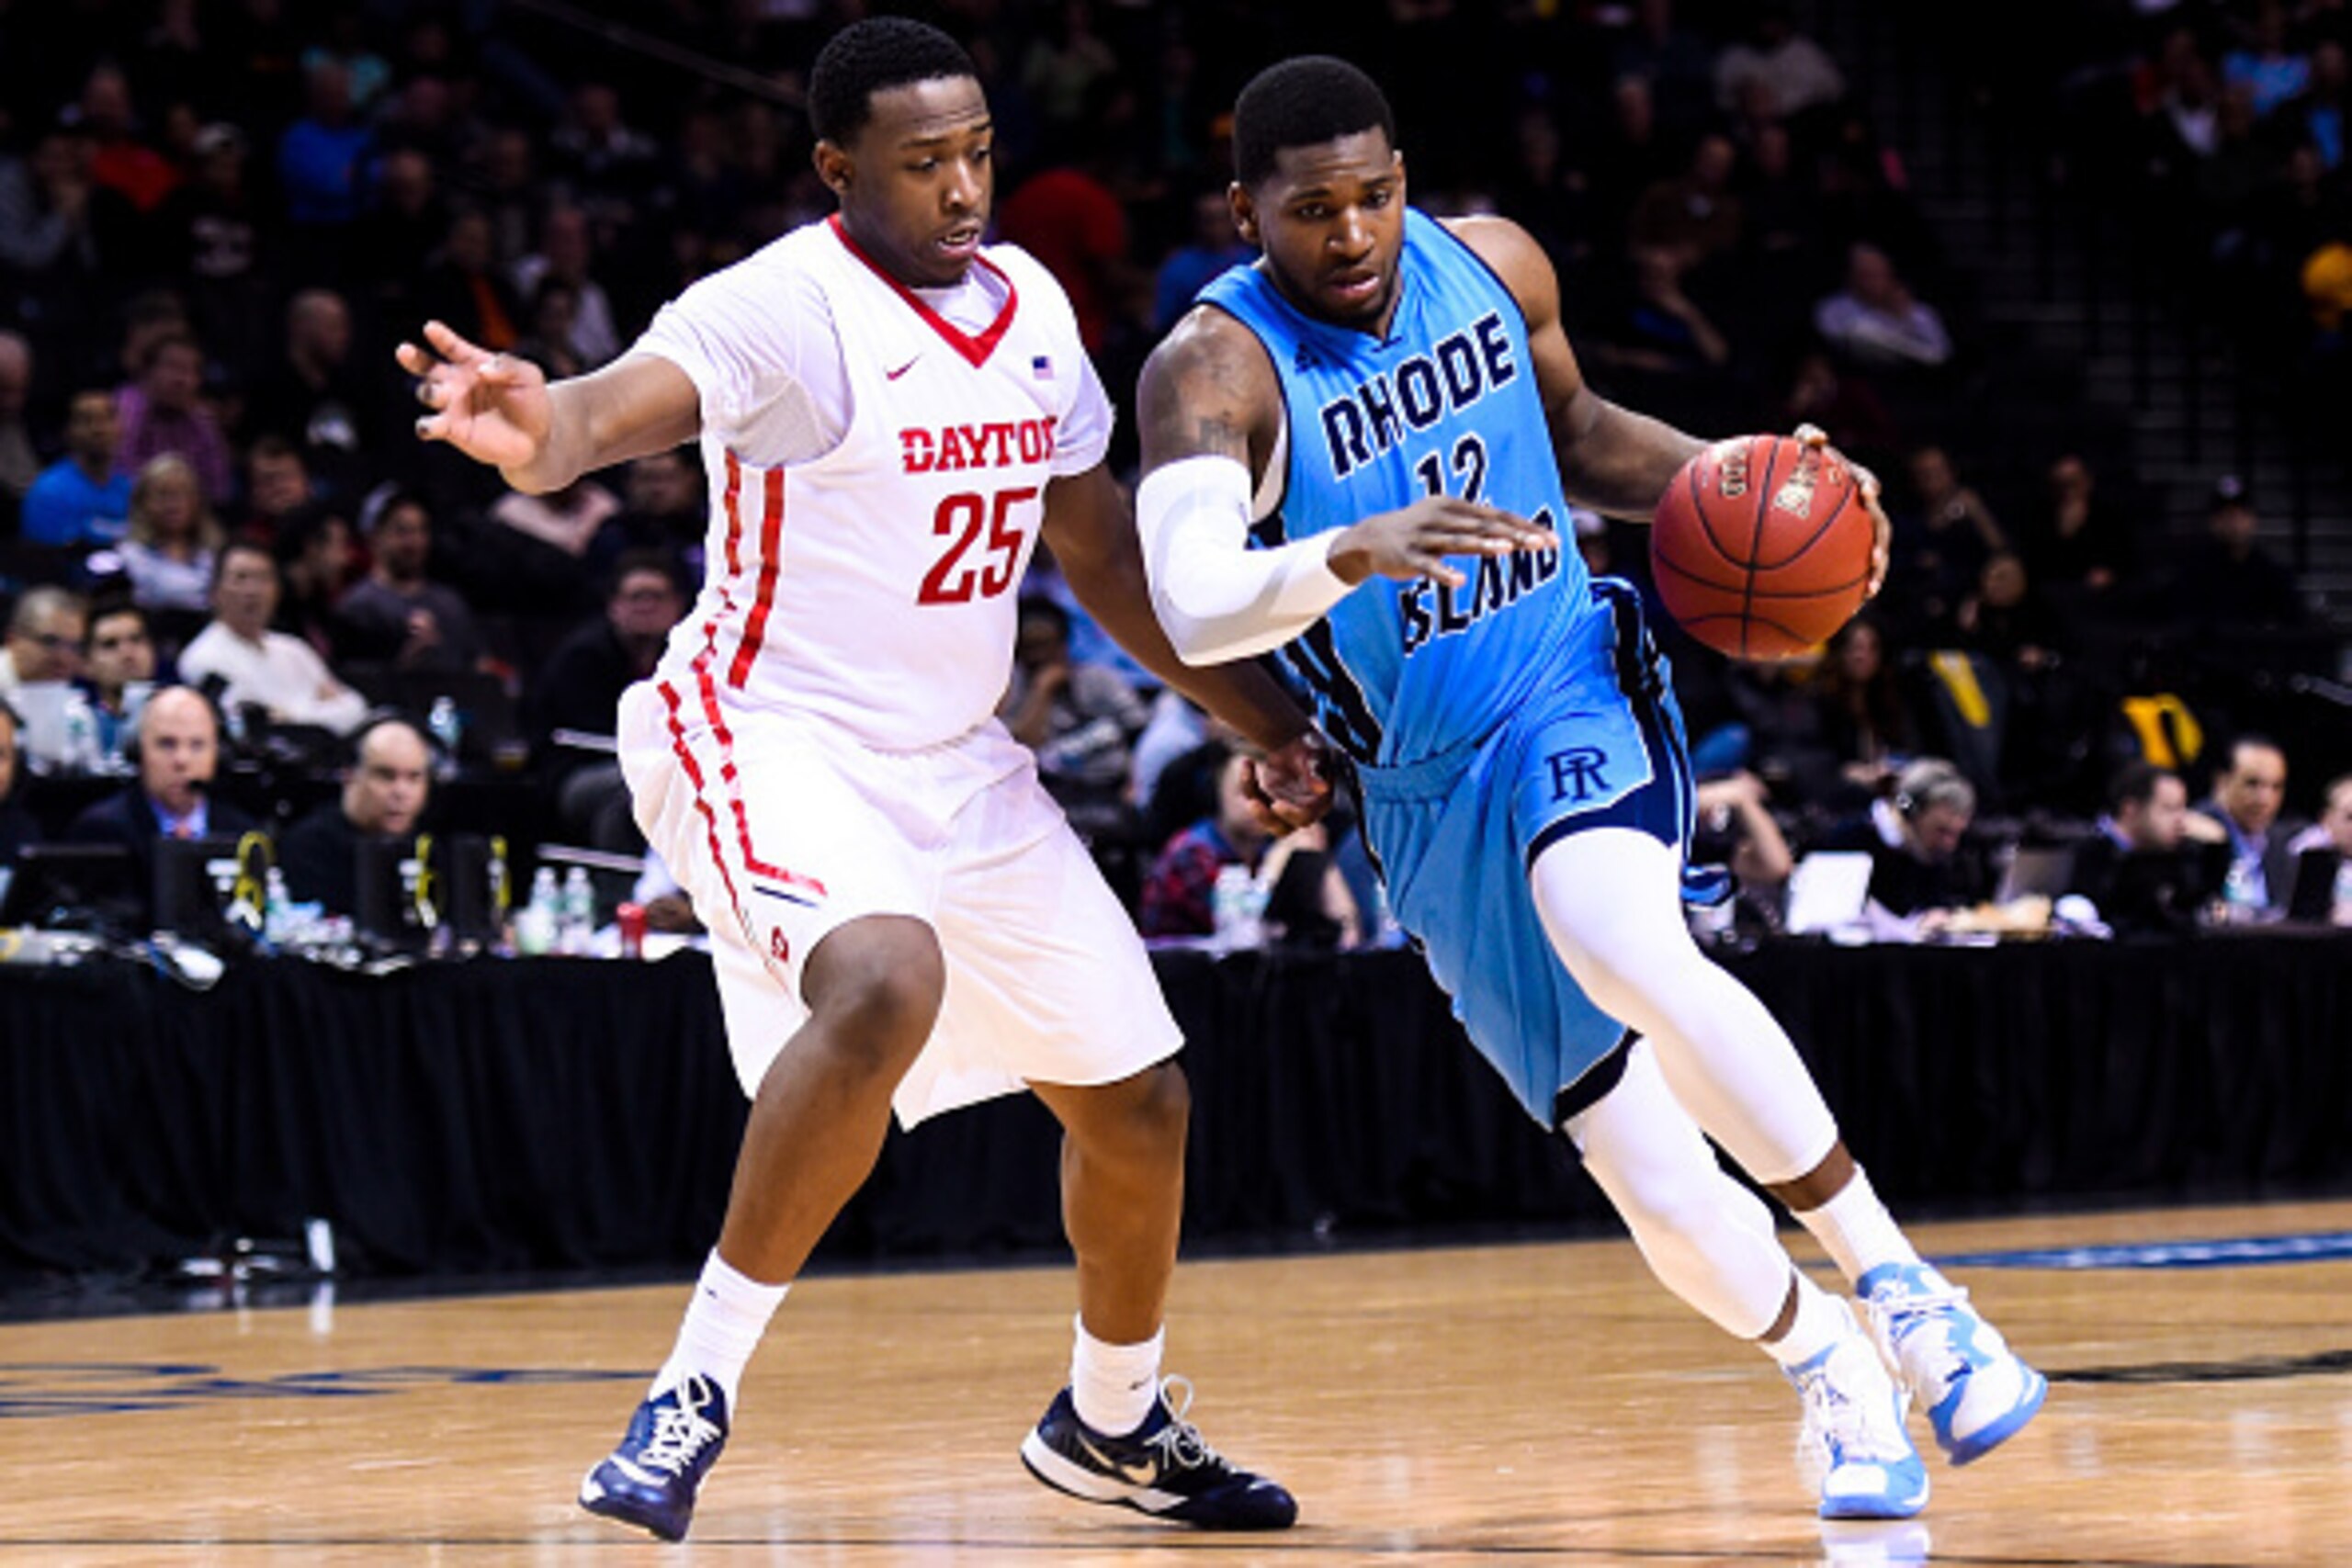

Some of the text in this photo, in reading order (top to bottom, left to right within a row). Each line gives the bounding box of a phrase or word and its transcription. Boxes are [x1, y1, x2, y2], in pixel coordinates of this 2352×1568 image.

[1319, 308, 1517, 479] RHODE
[1415, 433, 1488, 504] 12
[916, 487, 1038, 606] 25
